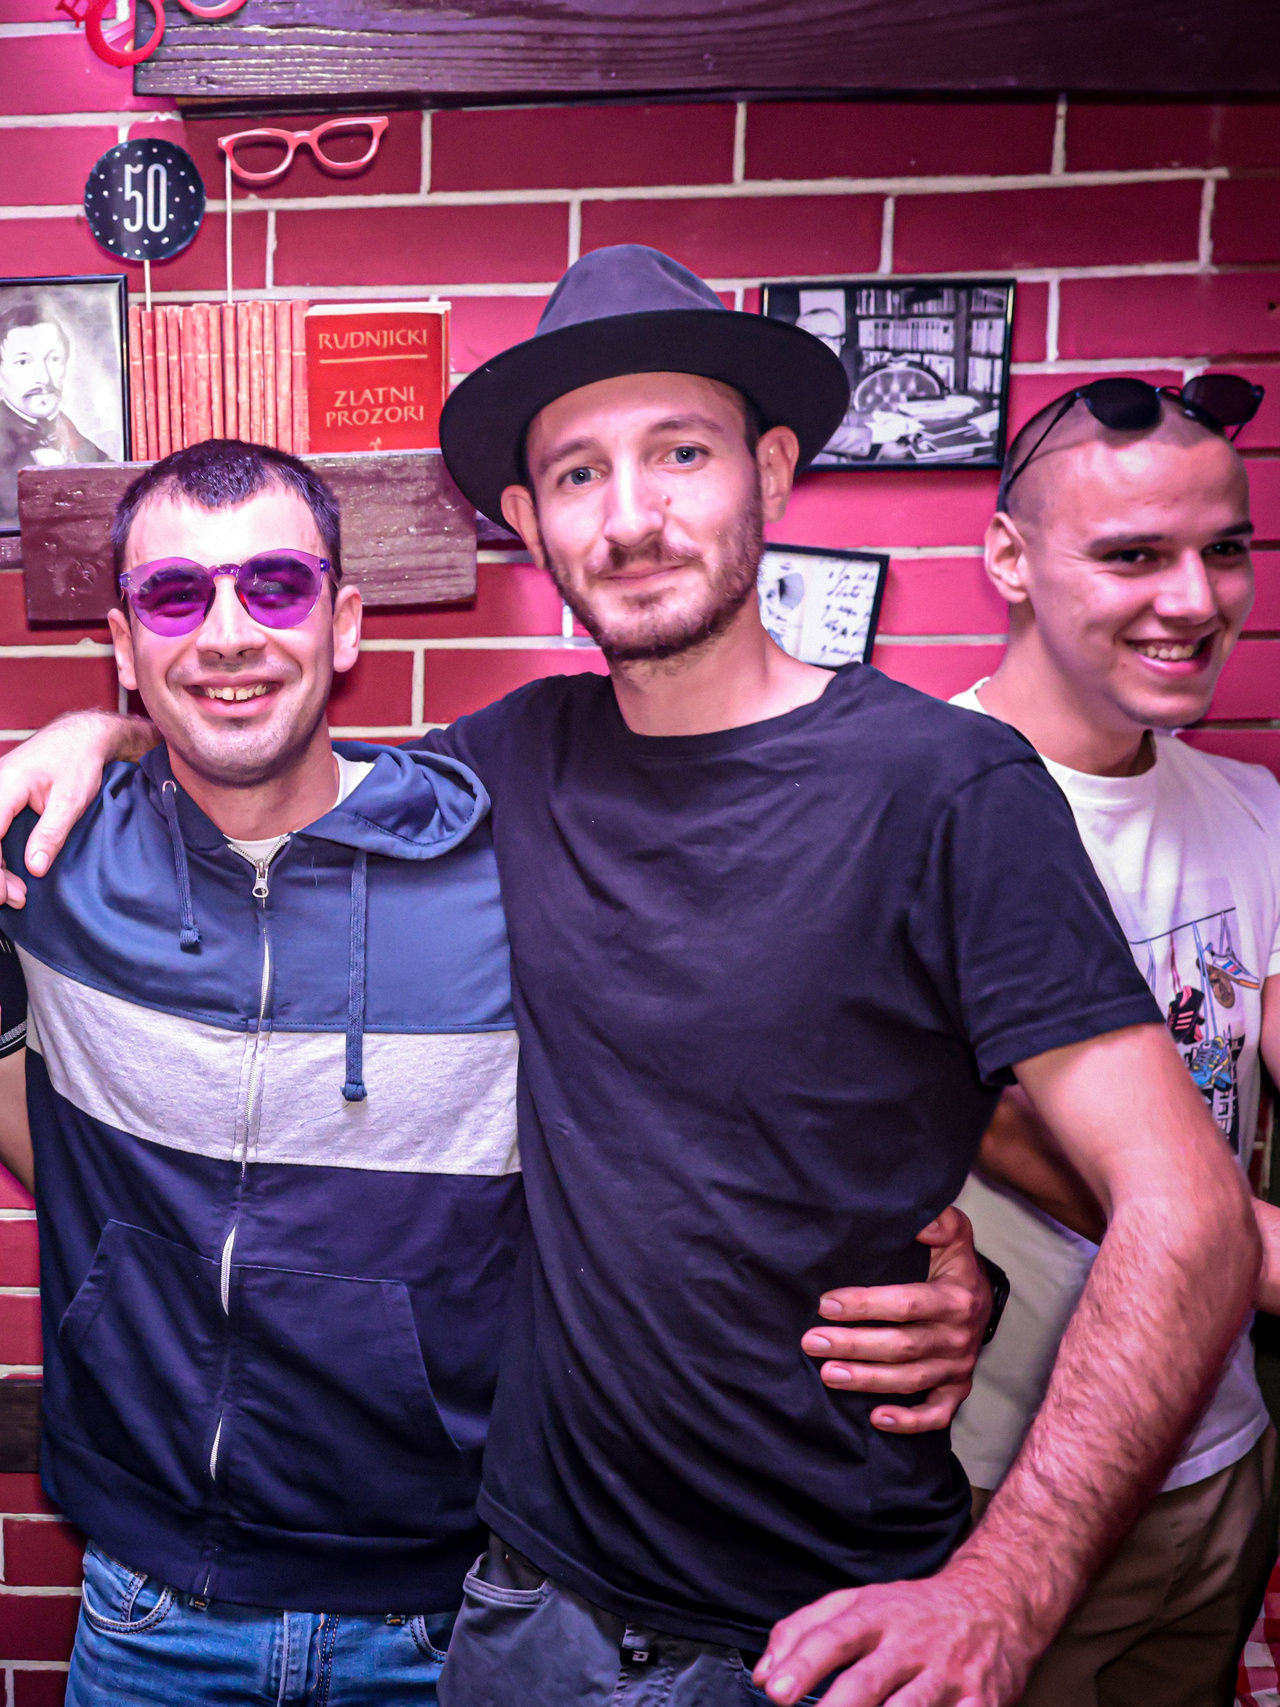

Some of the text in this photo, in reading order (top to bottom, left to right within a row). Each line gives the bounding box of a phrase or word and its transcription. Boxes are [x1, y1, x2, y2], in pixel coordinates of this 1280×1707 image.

[123, 163, 167, 233] 50
[318, 328, 428, 350] RUDNJICKI
[333, 385, 415, 408] ZLATNI
[325, 405, 425, 428] PROZORI
